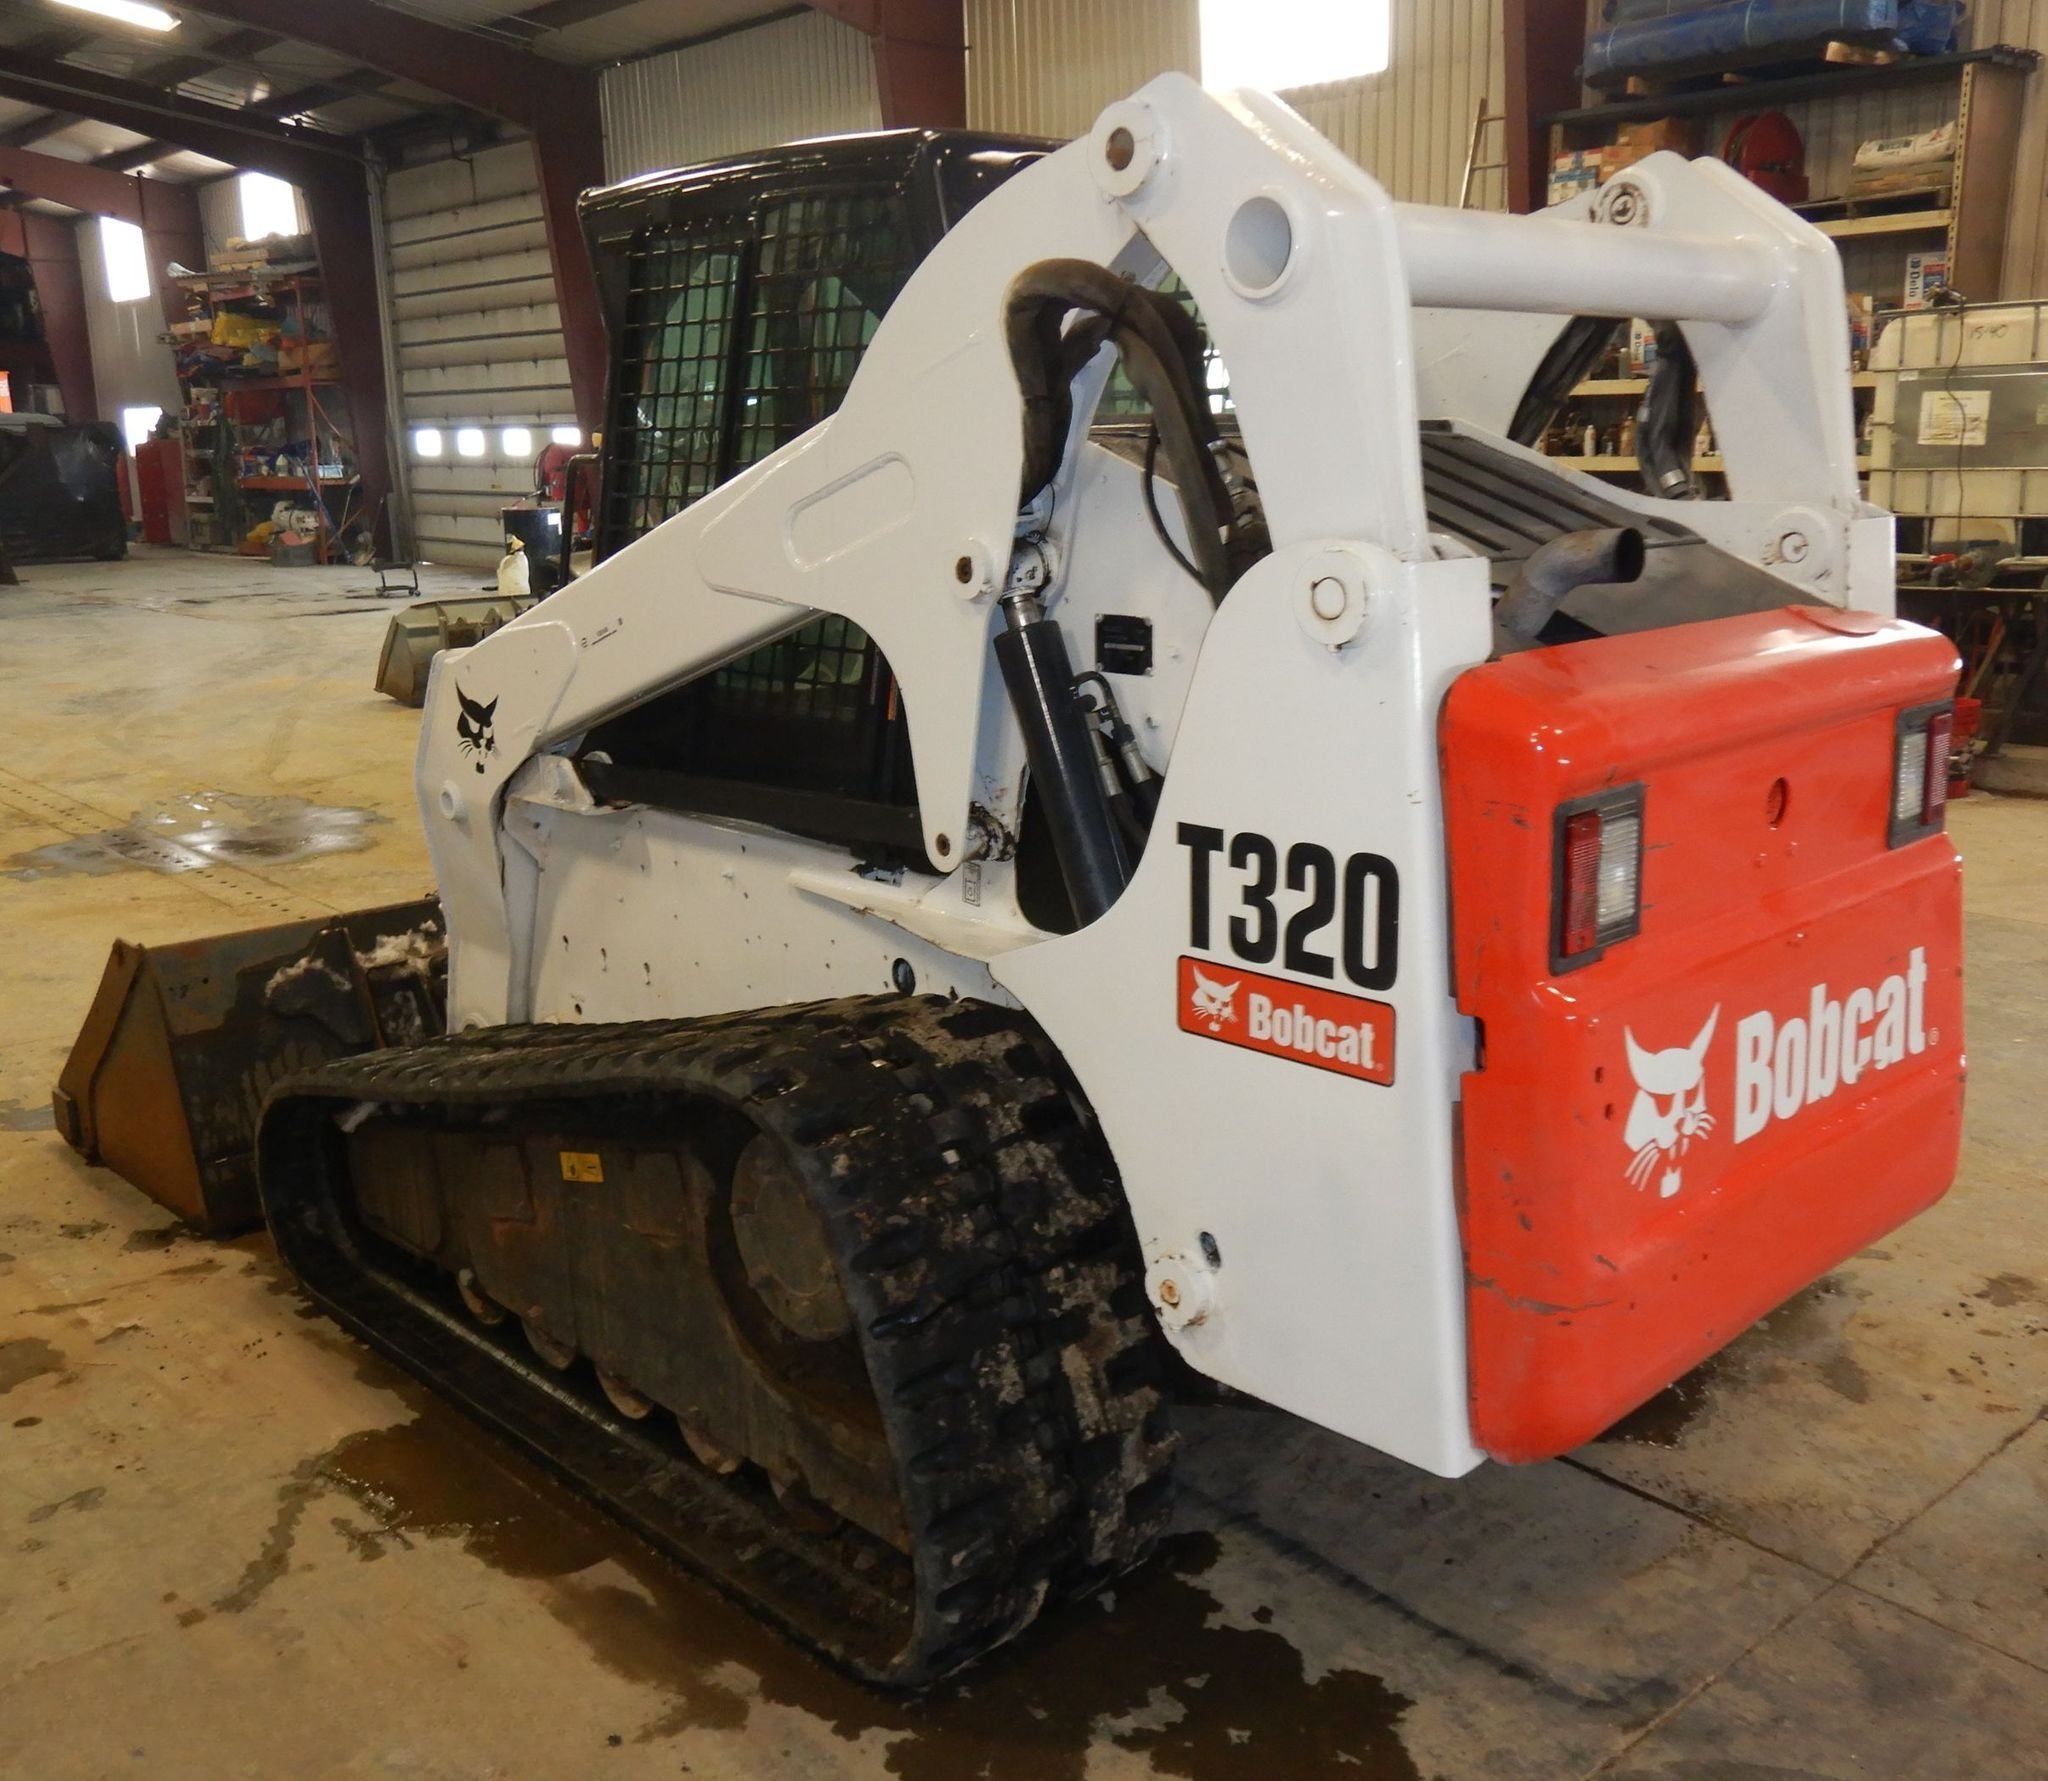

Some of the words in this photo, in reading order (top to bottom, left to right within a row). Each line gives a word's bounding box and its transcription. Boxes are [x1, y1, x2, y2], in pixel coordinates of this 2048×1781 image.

[1177, 821, 1400, 992] T320
[1248, 992, 1377, 1070] Bobcat
[1734, 946, 1928, 1144] Bobcat
